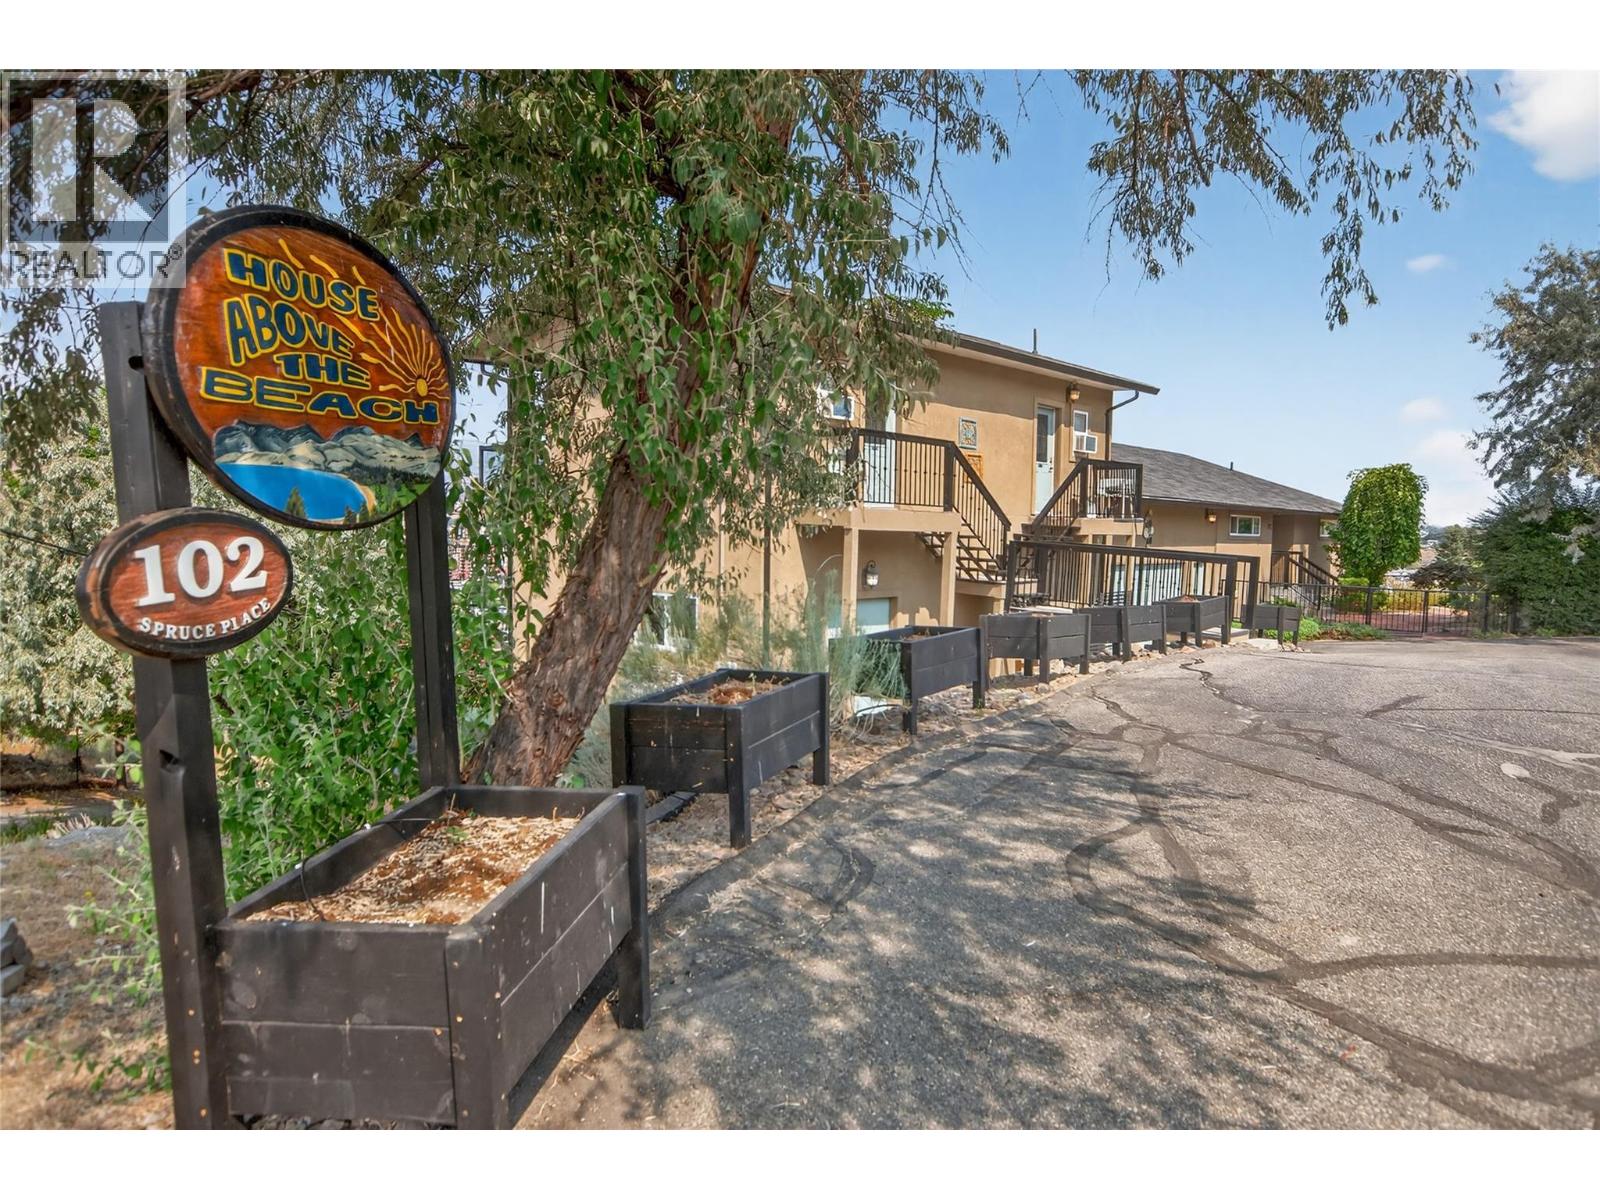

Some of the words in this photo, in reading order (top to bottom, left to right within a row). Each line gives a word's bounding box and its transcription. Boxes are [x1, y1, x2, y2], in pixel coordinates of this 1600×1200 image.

[224, 248, 381, 321] HOUSE
[224, 294, 354, 367] ABOVE
[200, 366, 441, 425] BEACH
[274, 352, 371, 390] THE
[134, 536, 269, 607] 102
[138, 617, 216, 640] SPRUCE
[220, 597, 271, 634] PLACE
